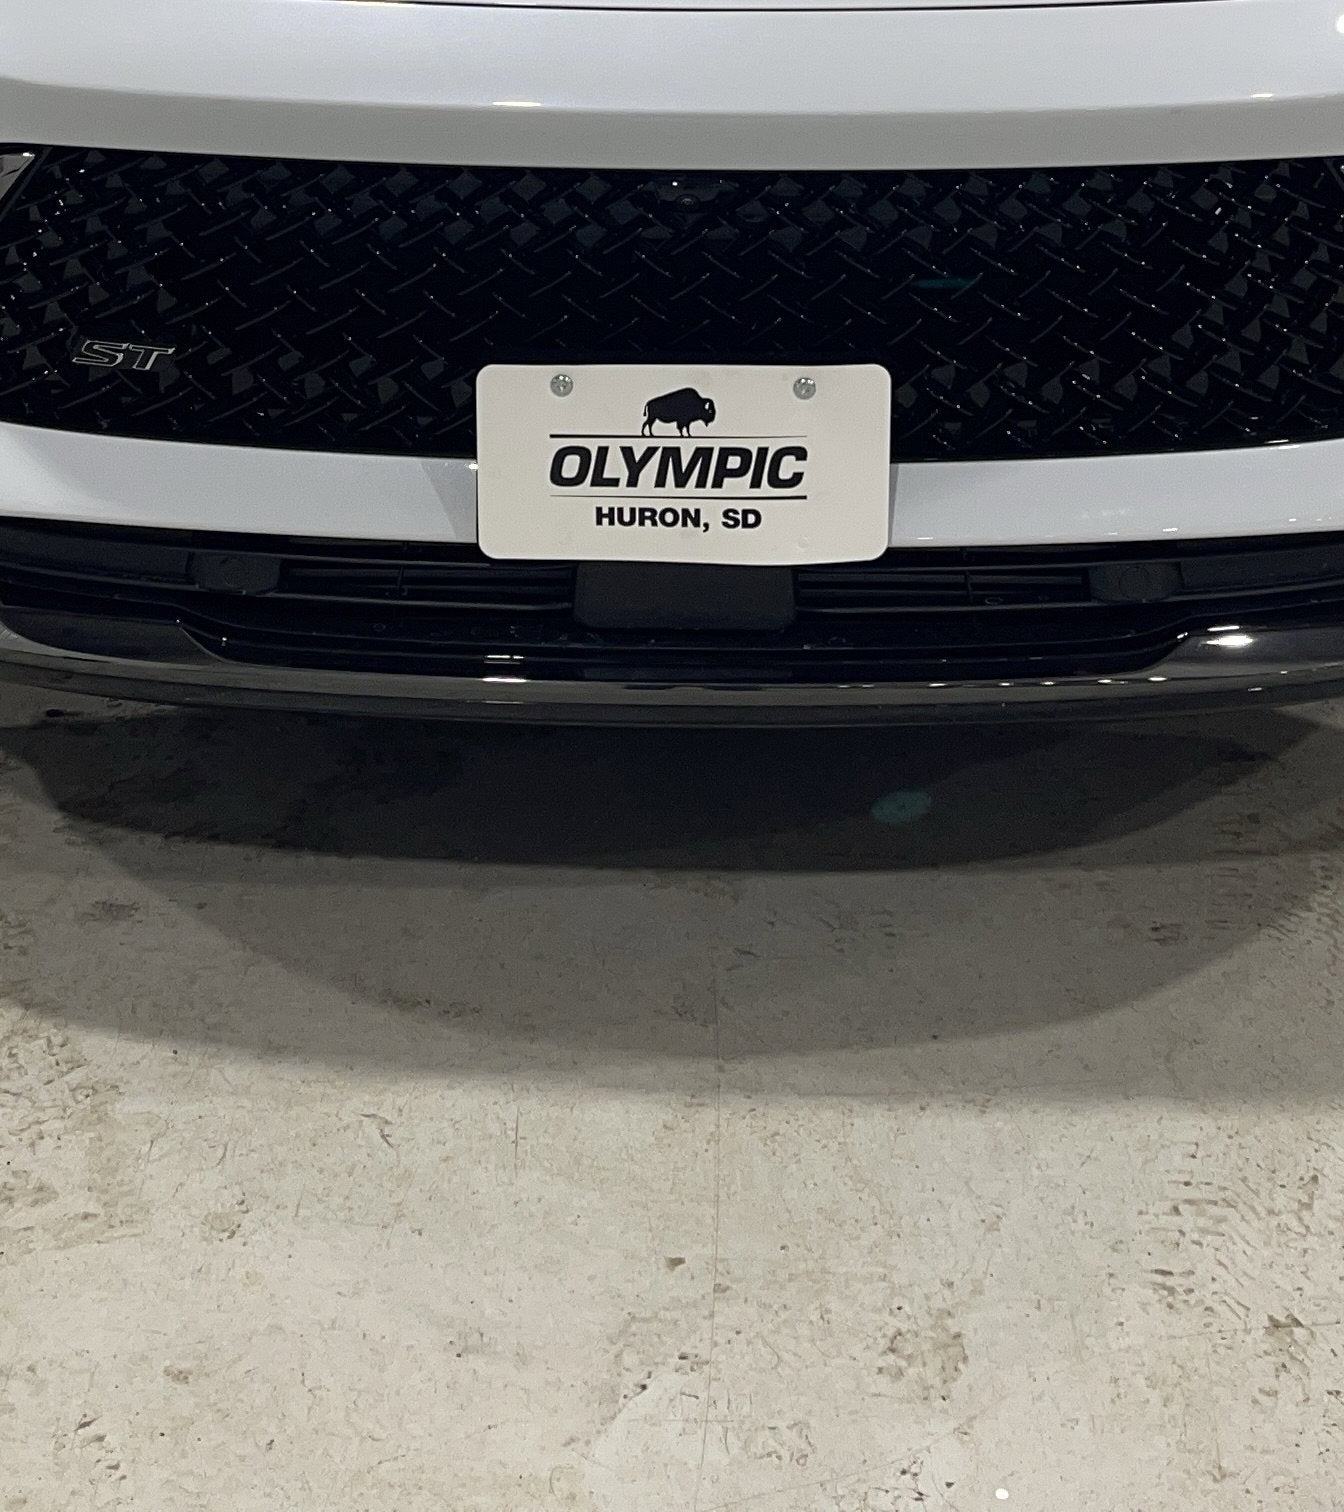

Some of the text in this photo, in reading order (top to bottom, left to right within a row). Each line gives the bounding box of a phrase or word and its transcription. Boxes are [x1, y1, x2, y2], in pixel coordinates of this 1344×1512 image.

[72, 340, 176, 371] ST
[549, 445, 809, 489] OLYMPIC
[595, 506, 763, 533] HURON, SD
